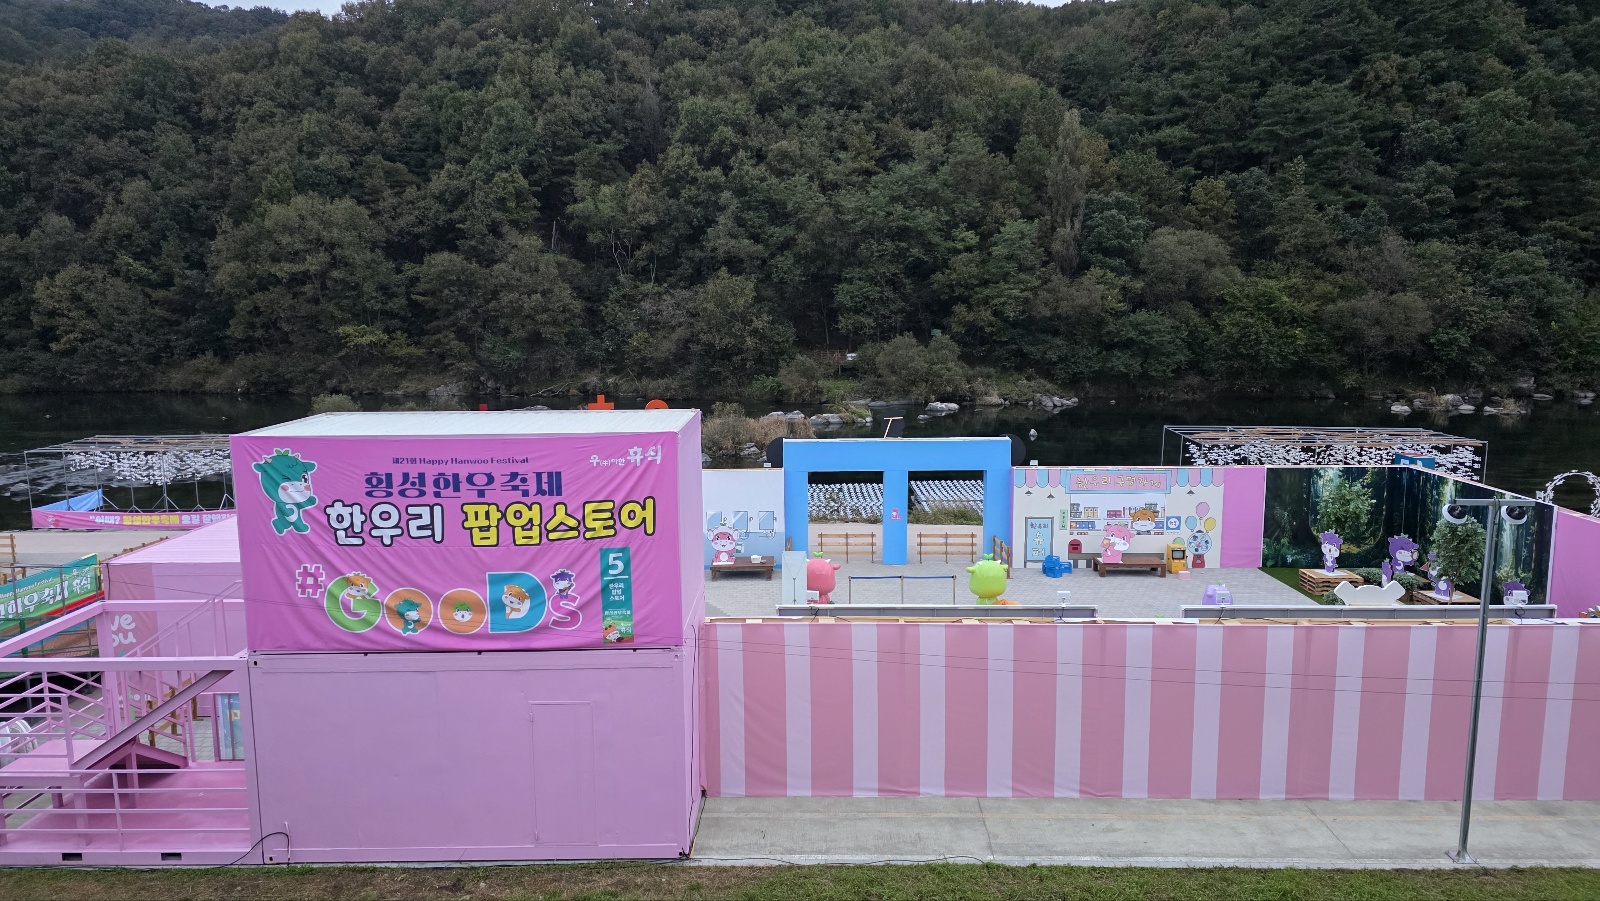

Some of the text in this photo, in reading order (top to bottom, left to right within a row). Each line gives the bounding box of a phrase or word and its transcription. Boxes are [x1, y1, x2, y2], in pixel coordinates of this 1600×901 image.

[419, 457, 449, 466] Happy
[450, 457, 489, 465] Hanwoo
[490, 456, 529, 464] Festival
[627, 445, 662, 467] 휴식
[364, 470, 563, 498] 횡성한우축제
[324, 496, 656, 546] 한우리 팝업스토어
[608, 552, 625, 575] 5
